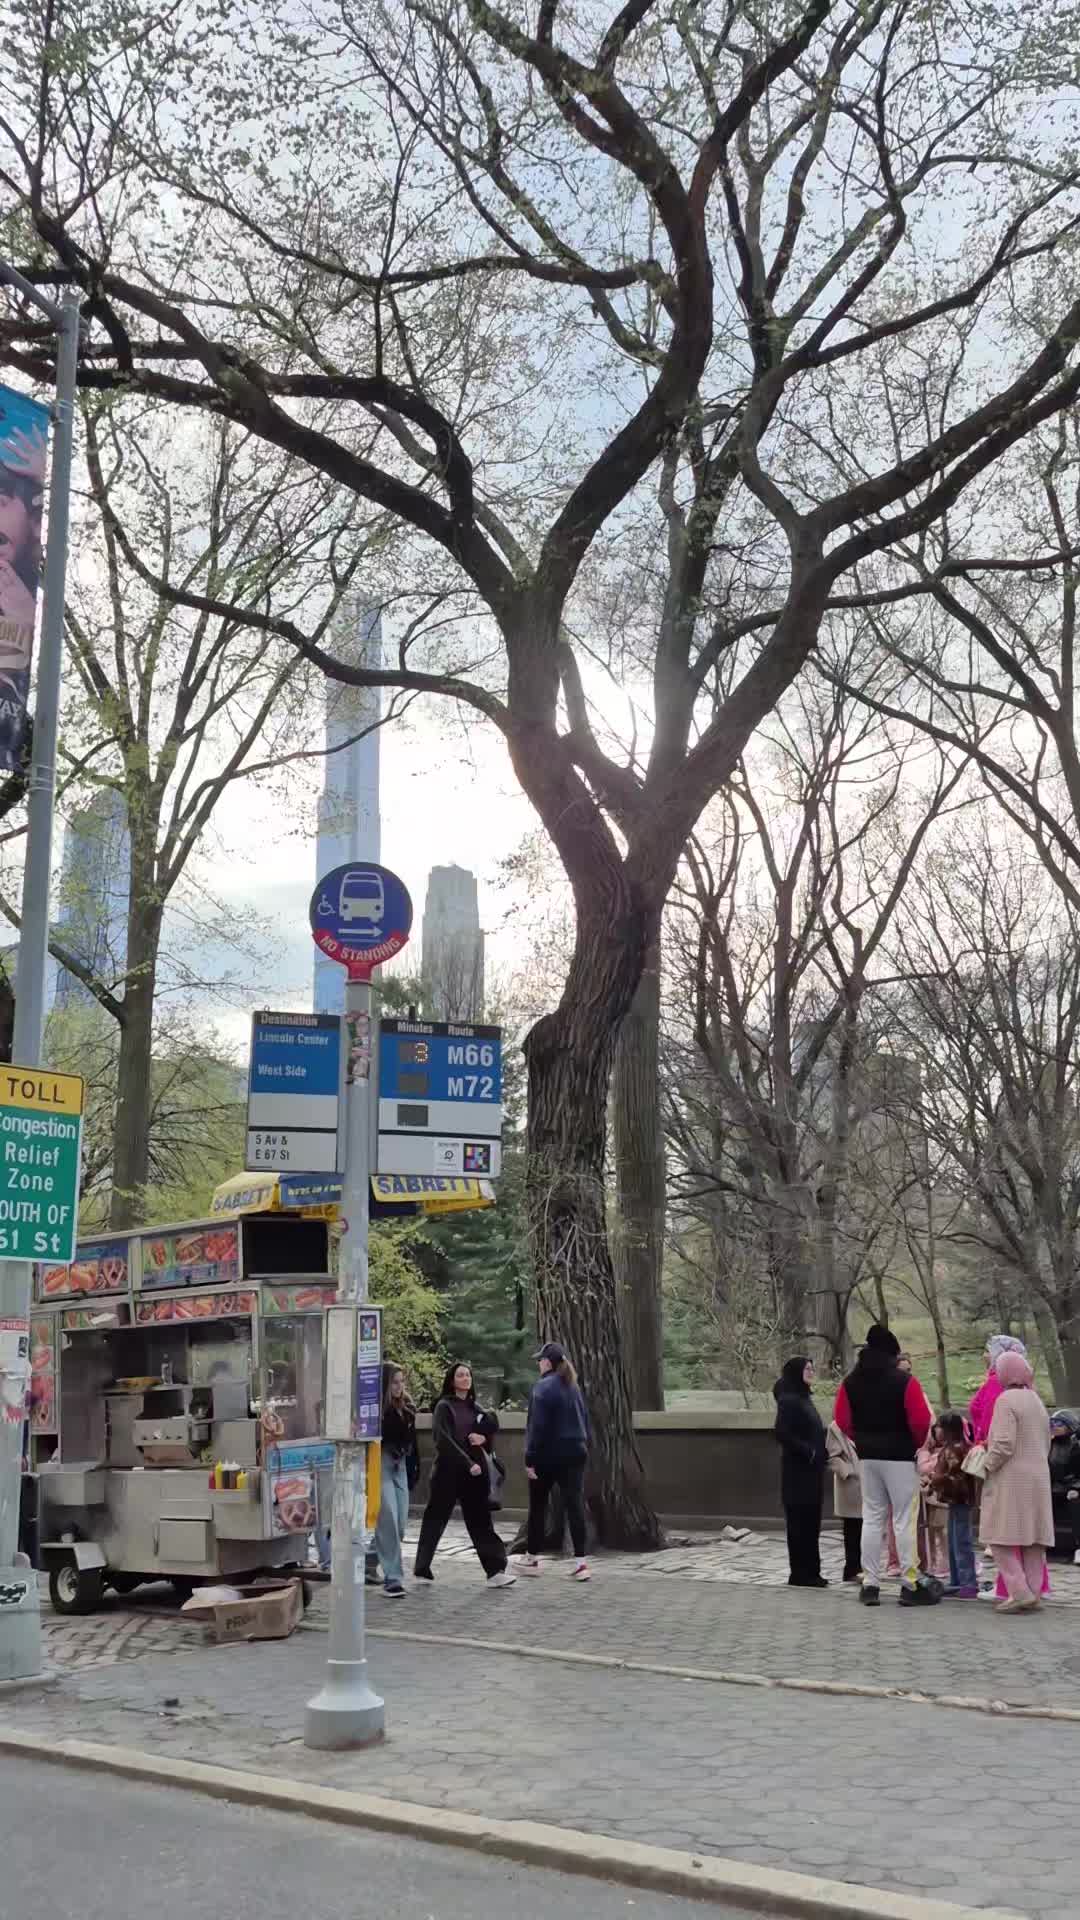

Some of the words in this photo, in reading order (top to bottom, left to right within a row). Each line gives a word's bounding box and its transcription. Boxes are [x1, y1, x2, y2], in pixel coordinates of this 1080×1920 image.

[0, 699, 21, 717] AY
[319, 936, 337, 952] NO
[341, 938, 400, 960] STANDING
[397, 1021, 433, 1034] Minutes
[447, 1025, 474, 1037] Route
[415, 1041, 428, 1062] 3
[447, 1043, 494, 1067] M66
[258, 1064, 282, 1076] West
[285, 1064, 307, 1077] Side
[7, 1078, 65, 1104] TOLL
[447, 1075, 494, 1098] M72
[255, 1134, 262, 1145] 5
[264, 1134, 278, 1146] Av
[281, 1135, 288, 1146] &
[5, 1141, 60, 1168] Relief
[255, 1148, 262, 1160] E
[264, 1148, 278, 1160] 67
[279, 1149, 290, 1161] St
[7, 1168, 54, 1191] Zone
[378, 1176, 471, 1194] SABRETT
[48, 1204, 71, 1225] OF
[33, 1231, 61, 1253] St
